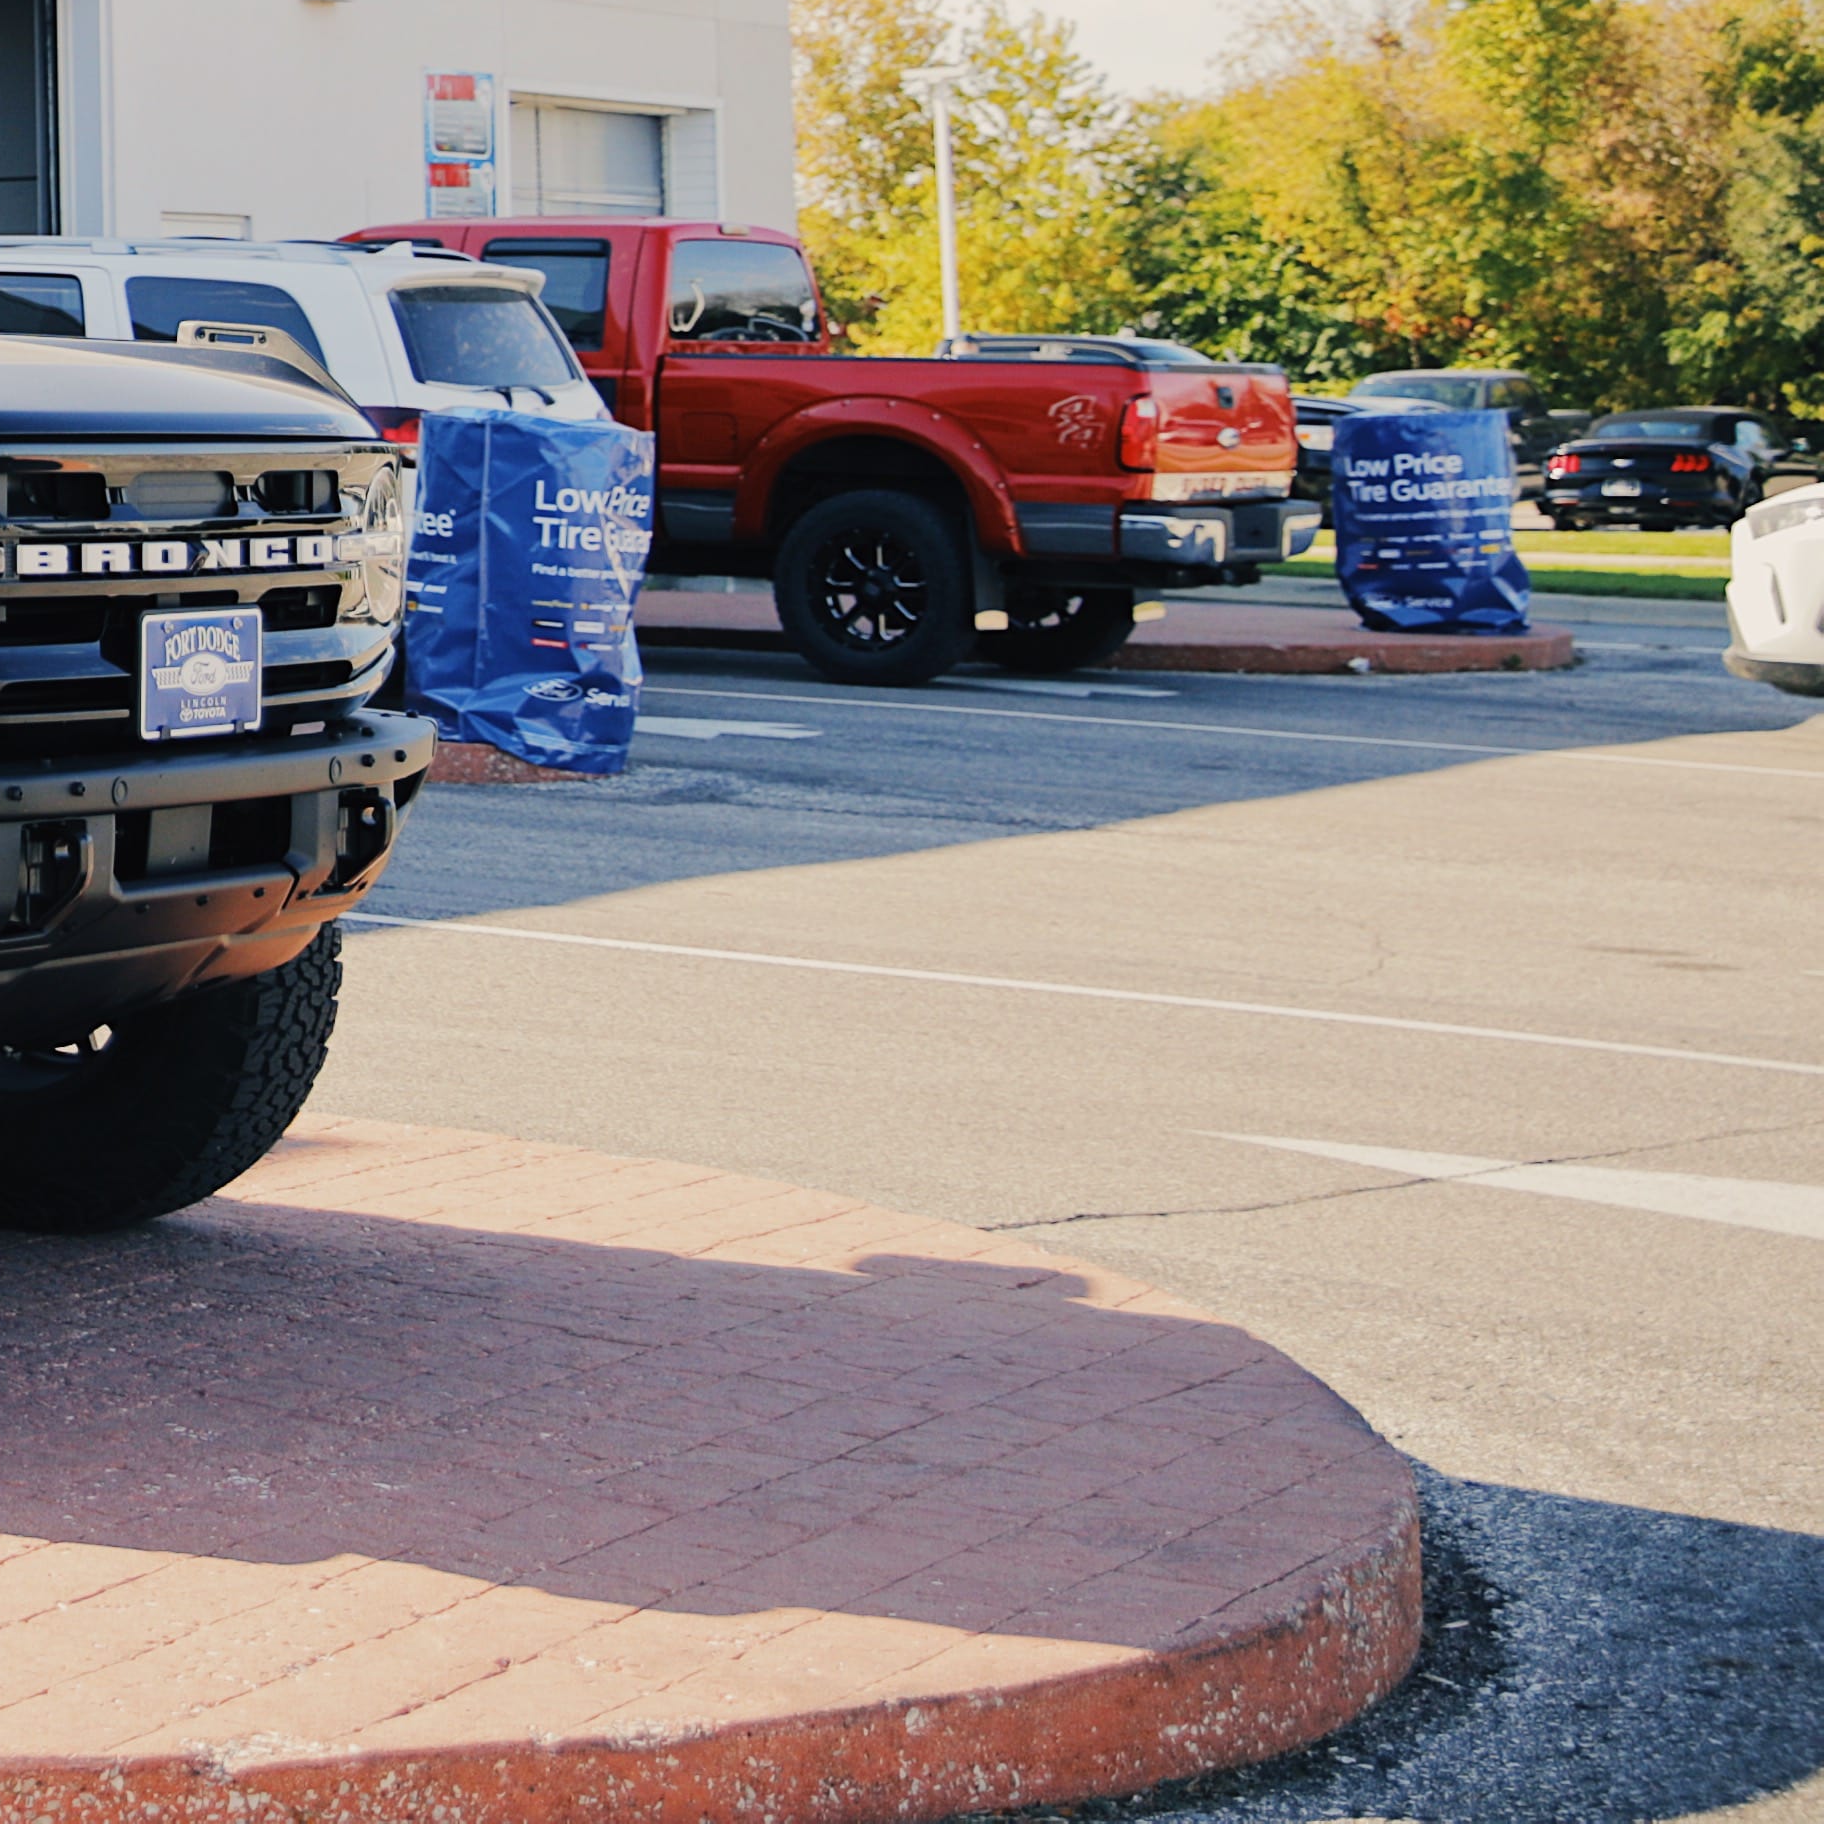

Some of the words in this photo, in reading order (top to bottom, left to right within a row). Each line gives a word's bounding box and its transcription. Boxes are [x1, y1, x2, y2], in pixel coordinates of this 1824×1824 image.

[1343, 455, 1391, 477] Low
[1393, 452, 1463, 476] Price
[534, 479, 610, 514] Low
[608, 485, 651, 518] Price
[1347, 480, 1388, 503] Tire
[1390, 475, 1512, 503] Guarante
[532, 516, 601, 551] Tire
[16, 536, 333, 575] BRONCO
[165, 626, 197, 667] FORT
[198, 625, 241, 662] DODGE
[191, 661, 217, 685] Ford
[180, 695, 227, 709] LINCOLN
[193, 706, 227, 720] TOYOTA
